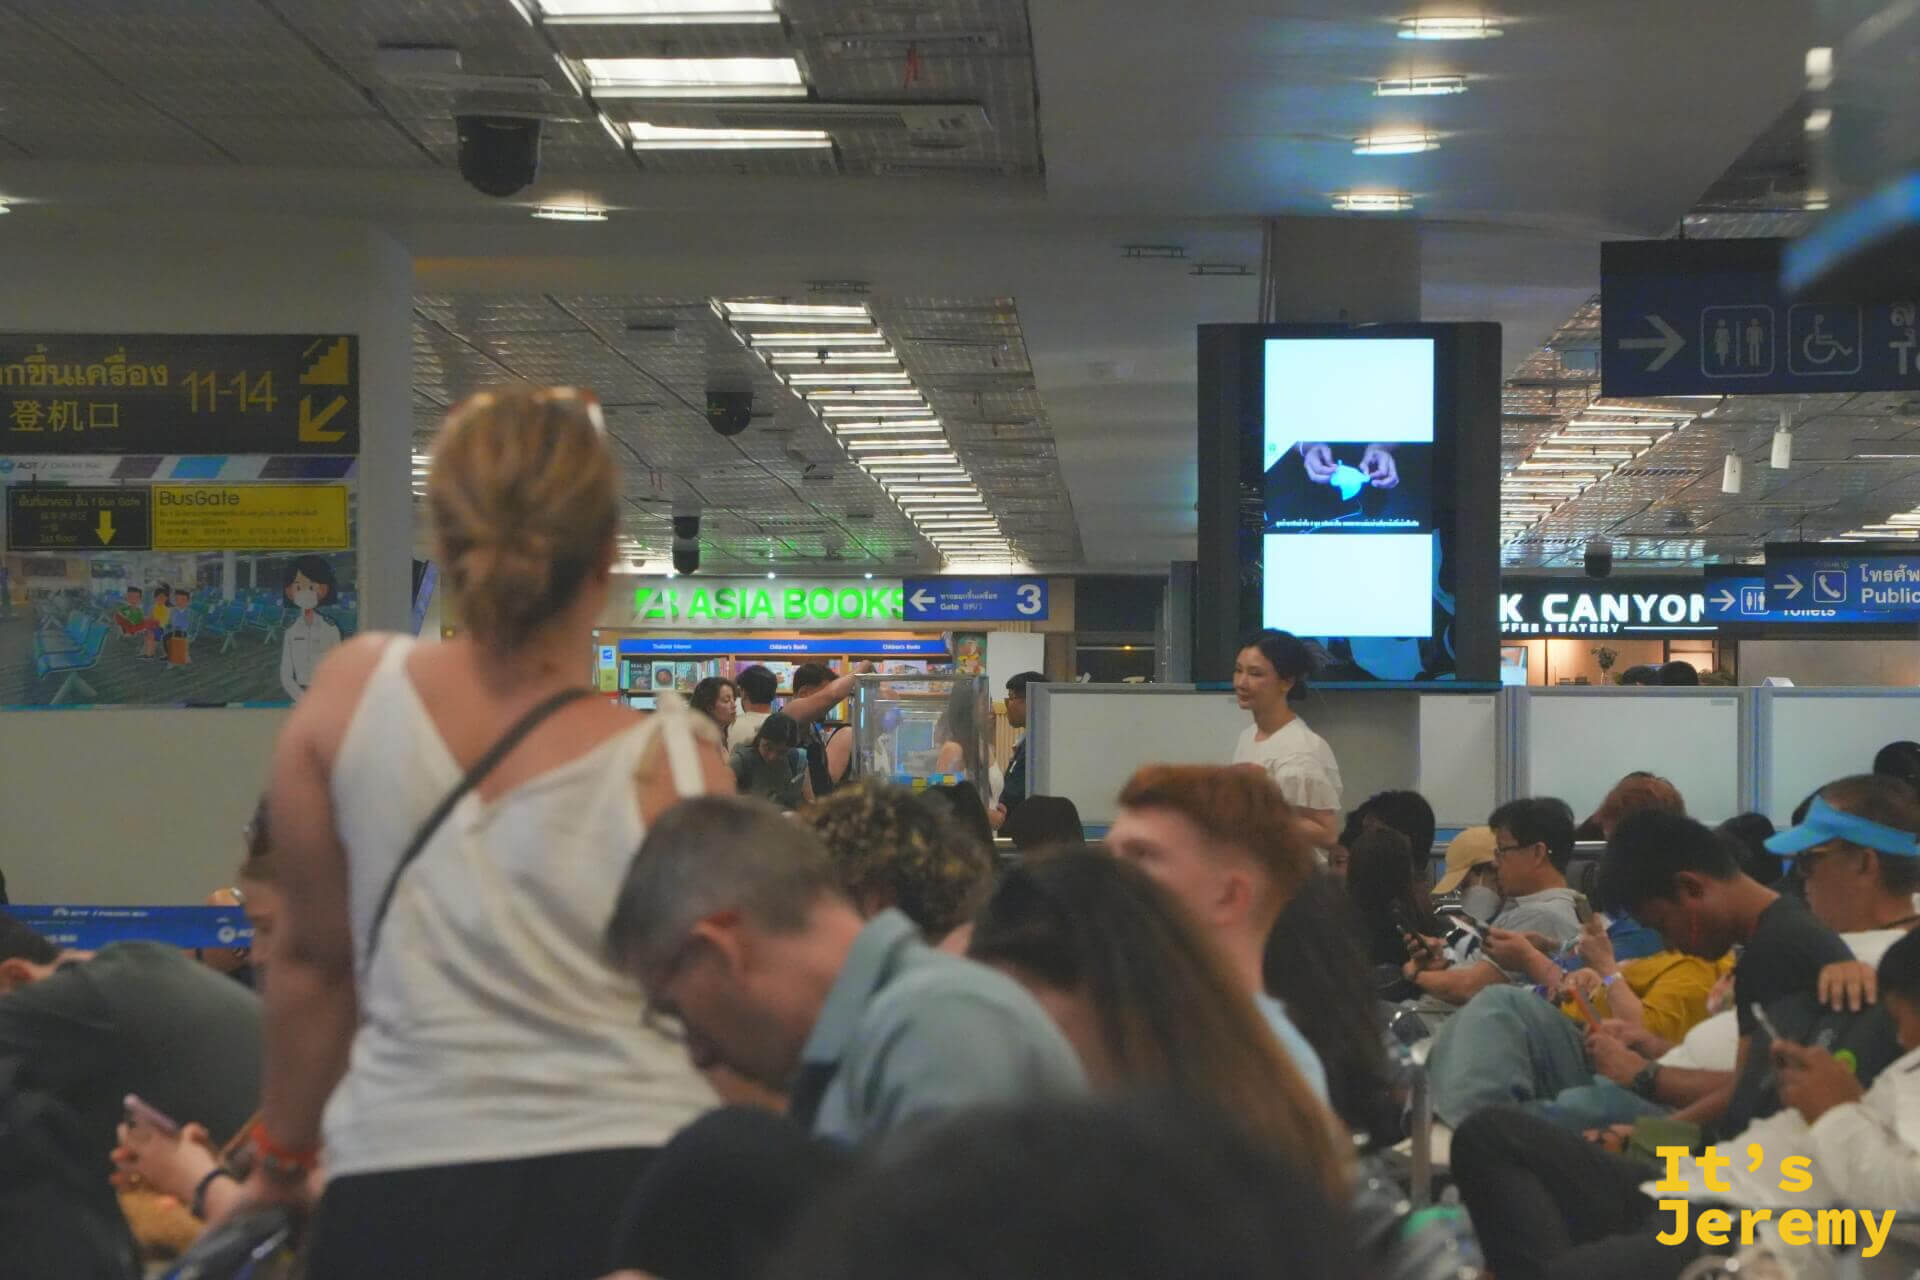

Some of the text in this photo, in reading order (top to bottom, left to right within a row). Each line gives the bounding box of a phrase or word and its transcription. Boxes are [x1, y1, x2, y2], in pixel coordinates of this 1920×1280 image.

[0, 343, 169, 386] กขึ้นเครื่อง
[183, 370, 278, 413] 11-14
[8, 400, 120, 432] 登机口
[159, 490, 241, 506] BusGate
[688, 588, 776, 620] ASIA
[783, 587, 904, 620] BOOKS
[1016, 583, 1042, 615] 3
[1861, 587, 1920, 605] Public
[1558, 623, 1620, 633] EATERY
